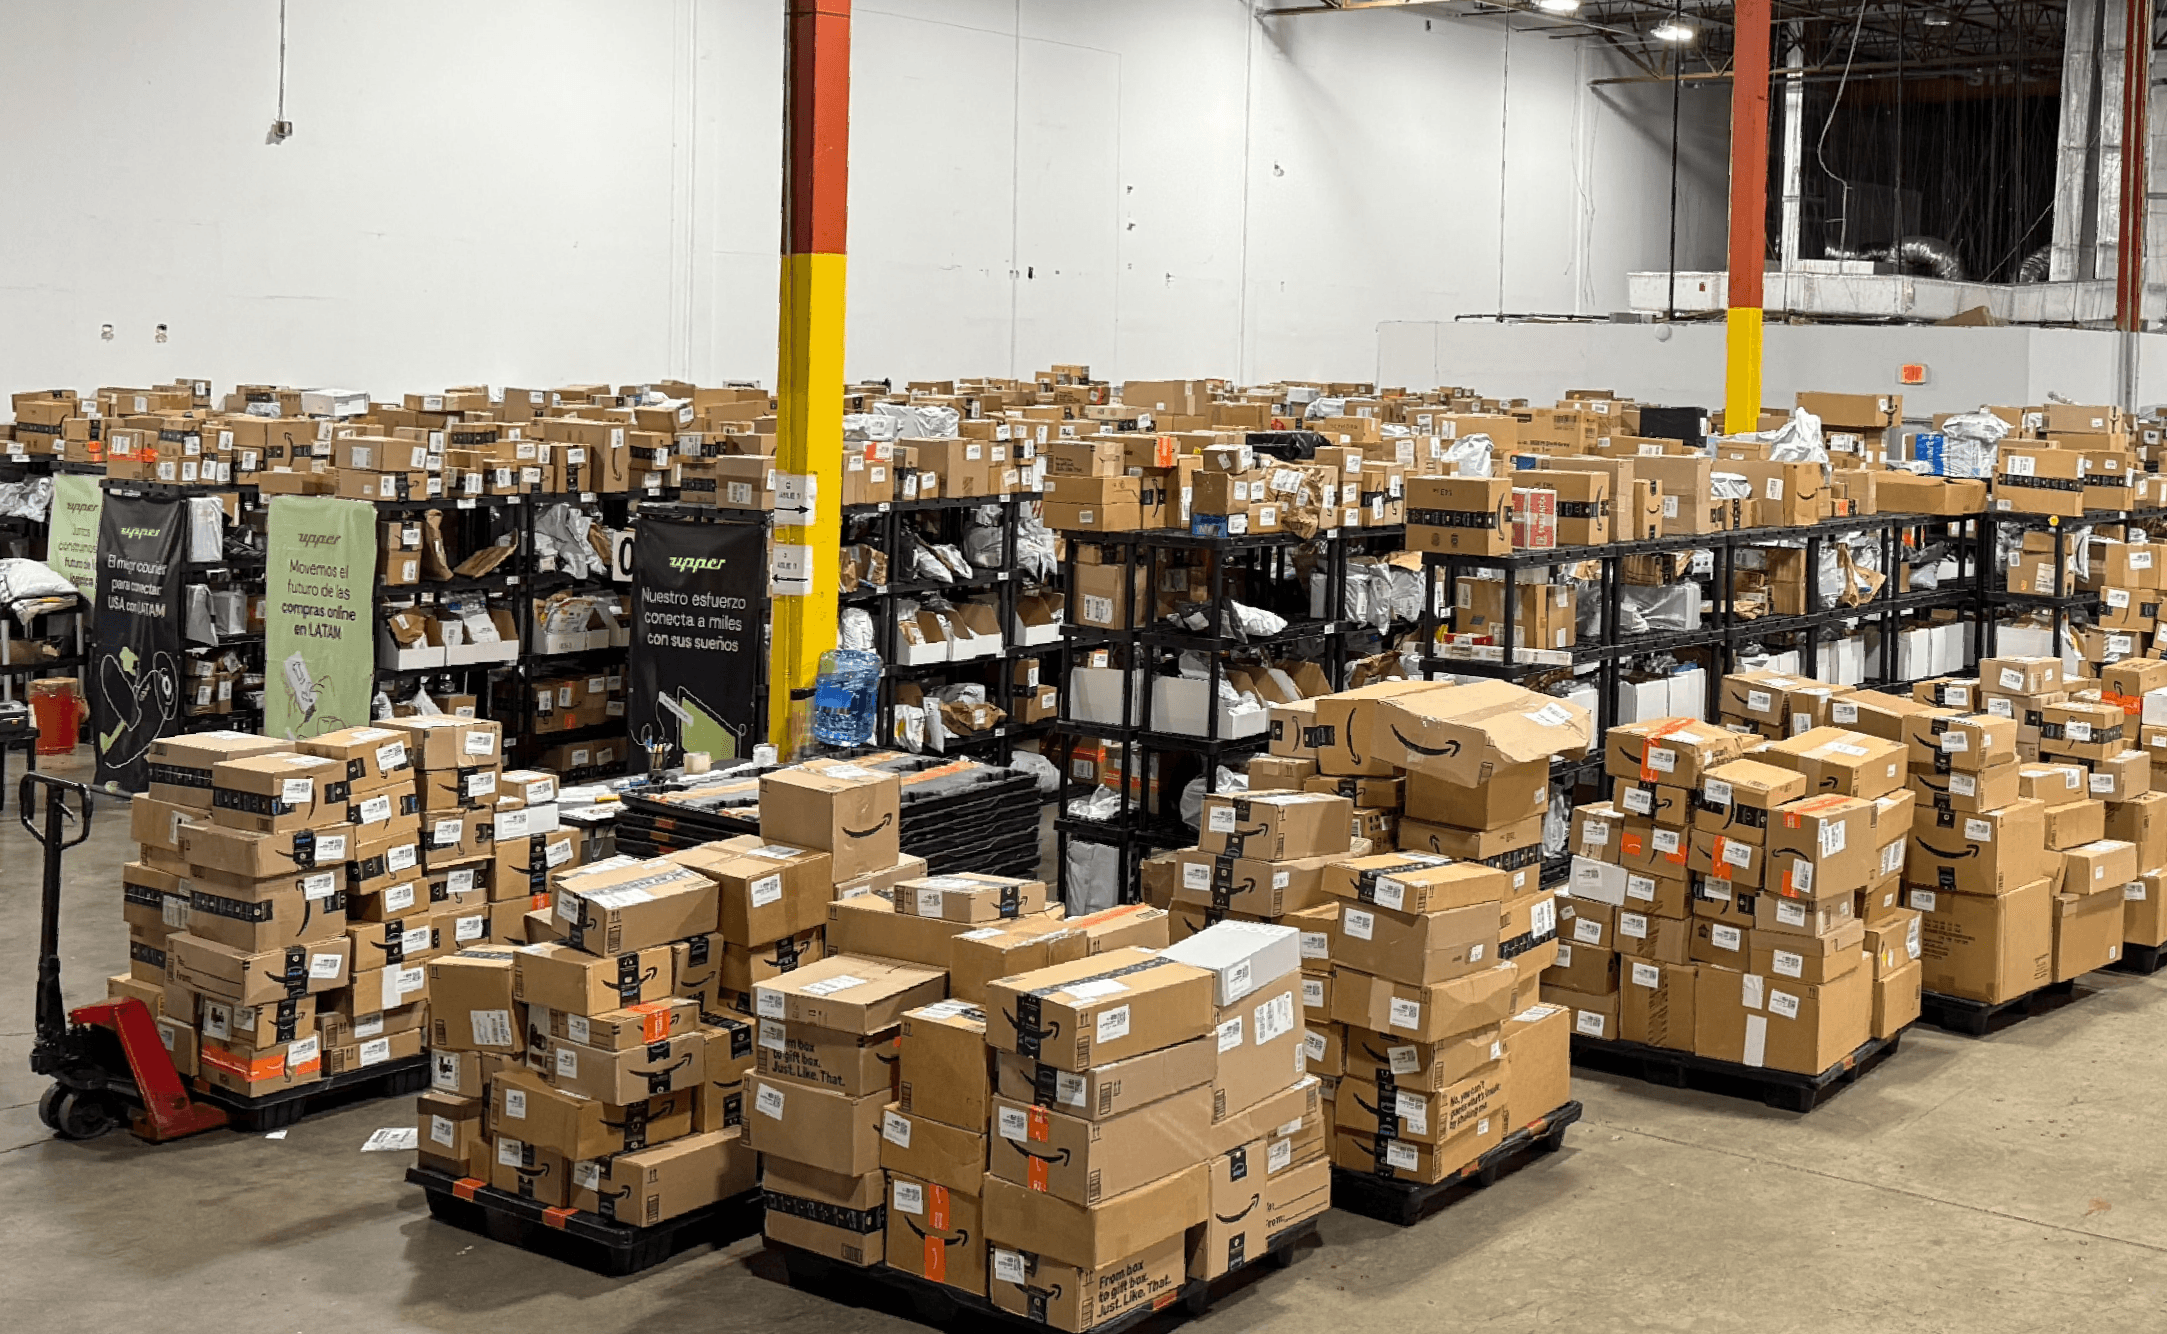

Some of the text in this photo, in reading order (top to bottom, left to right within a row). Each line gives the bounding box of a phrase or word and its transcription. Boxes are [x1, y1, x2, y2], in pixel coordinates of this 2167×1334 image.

[67, 502, 99, 515] upper
[121, 526, 160, 540] upper
[297, 533, 341, 548] upper
[137, 561, 168, 576] courier
[289, 559, 349, 579] Movemos el
[669, 556, 726, 574] upper
[111, 578, 131, 593] para
[287, 578, 351, 601] futuro de las
[107, 594, 167, 618] USA con LATAM
[641, 585, 747, 610] Nuestro esfuerzo
[281, 602, 357, 622] compras online
[644, 611, 742, 632] conecta a miles
[293, 621, 342, 640] en LATAM
[647, 632, 739, 653] con sus sueños
[797, 1038, 815, 1053] box
[785, 1050, 800, 1063] gift
[772, 1060, 846, 1087] Just. Like. That.
[1099, 1260, 1144, 1291] From box
[1097, 1273, 1172, 1318] Just. Like. That.
[1099, 1272, 1149, 1303] to gift box.
